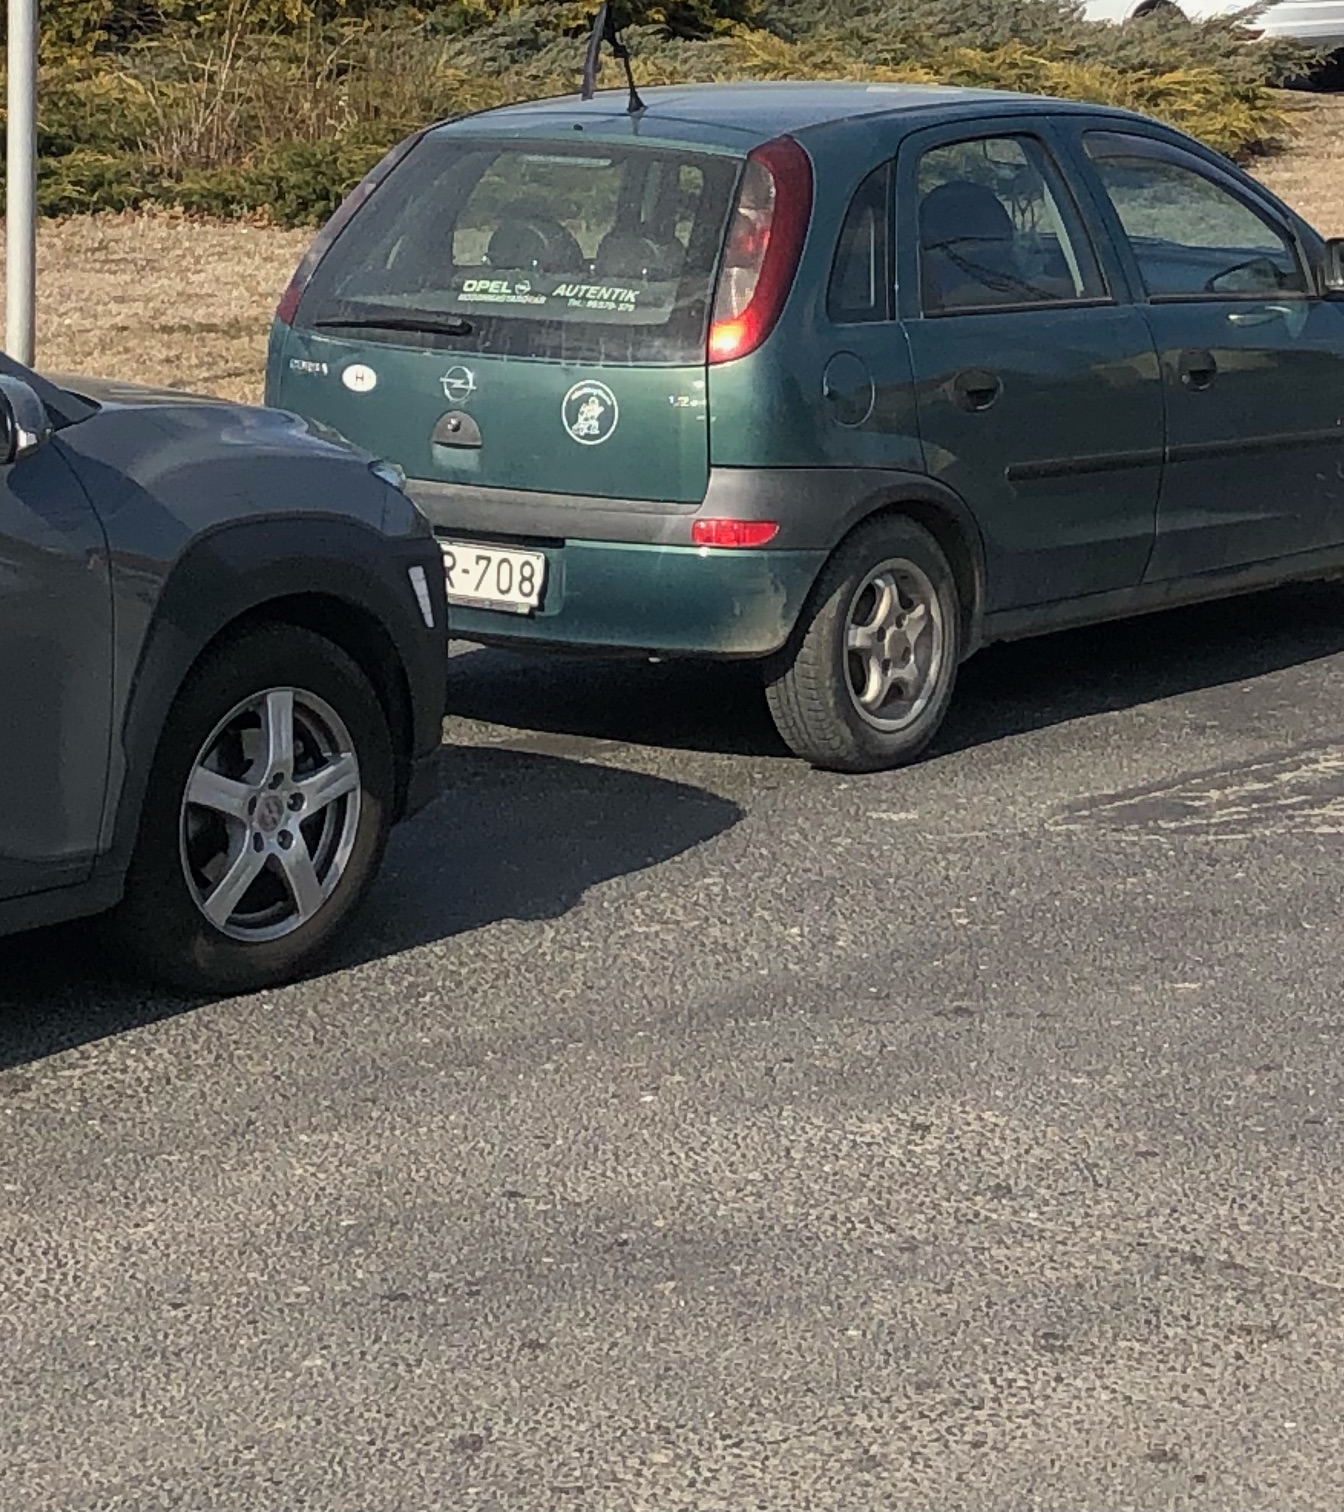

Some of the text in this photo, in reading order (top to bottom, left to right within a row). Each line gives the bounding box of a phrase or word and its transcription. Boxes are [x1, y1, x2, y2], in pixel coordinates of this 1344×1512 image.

[462, 279, 641, 303] OPEL AUTENTIK
[355, 371, 365, 382] H
